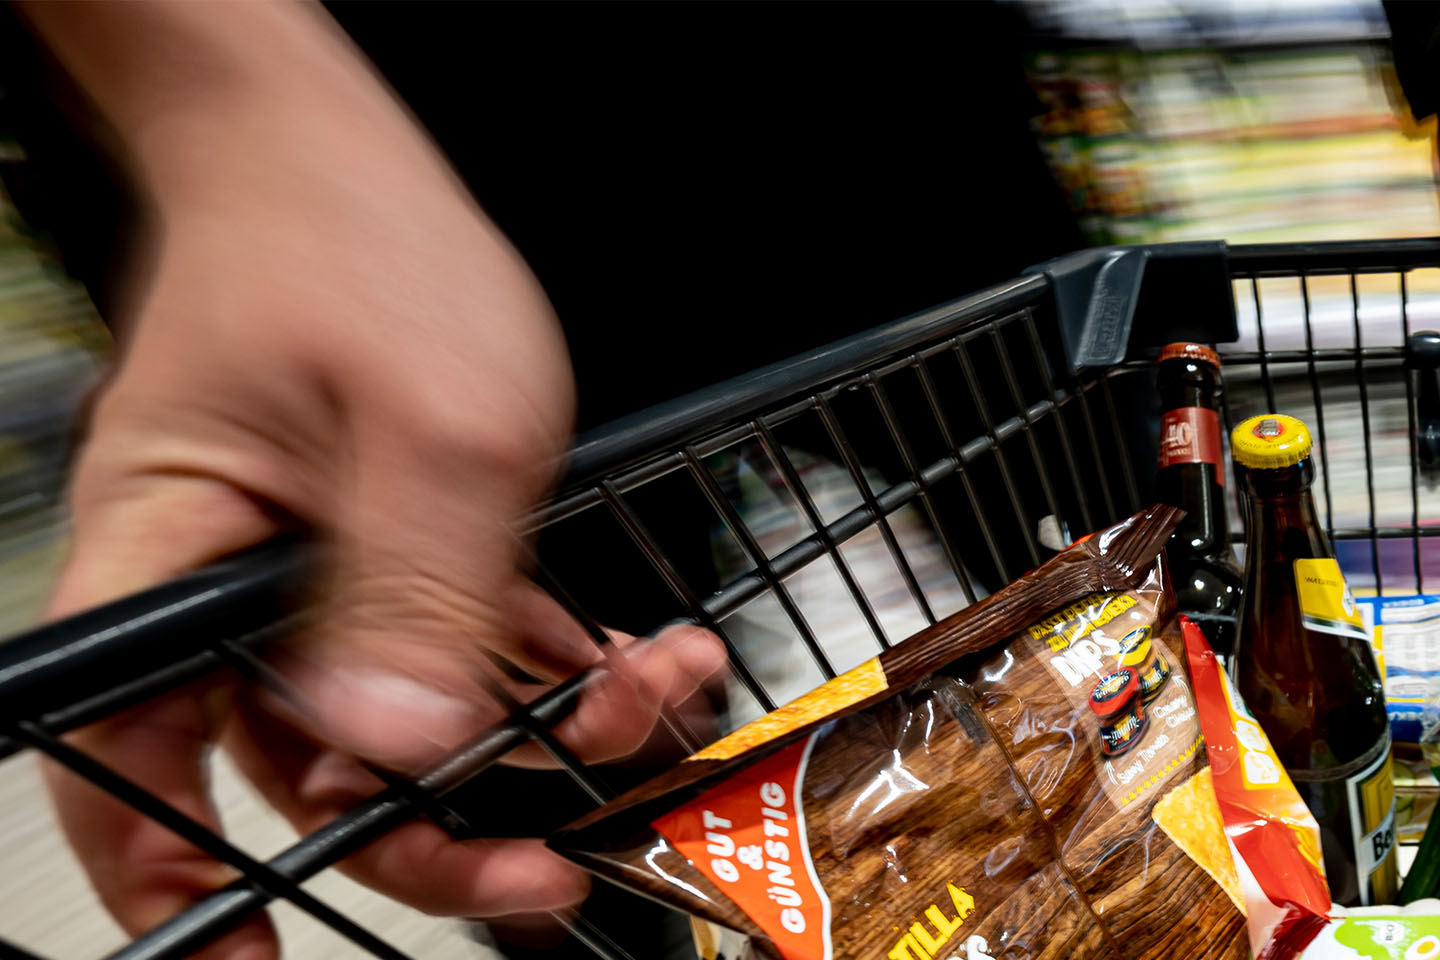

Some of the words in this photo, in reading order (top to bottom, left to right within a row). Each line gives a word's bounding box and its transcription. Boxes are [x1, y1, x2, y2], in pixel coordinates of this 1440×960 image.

[1050, 630, 1121, 687] DIPS
[703, 810, 739, 882] GUT
[737, 845, 764, 870] &
[760, 782, 806, 933] GÜNSTIG
